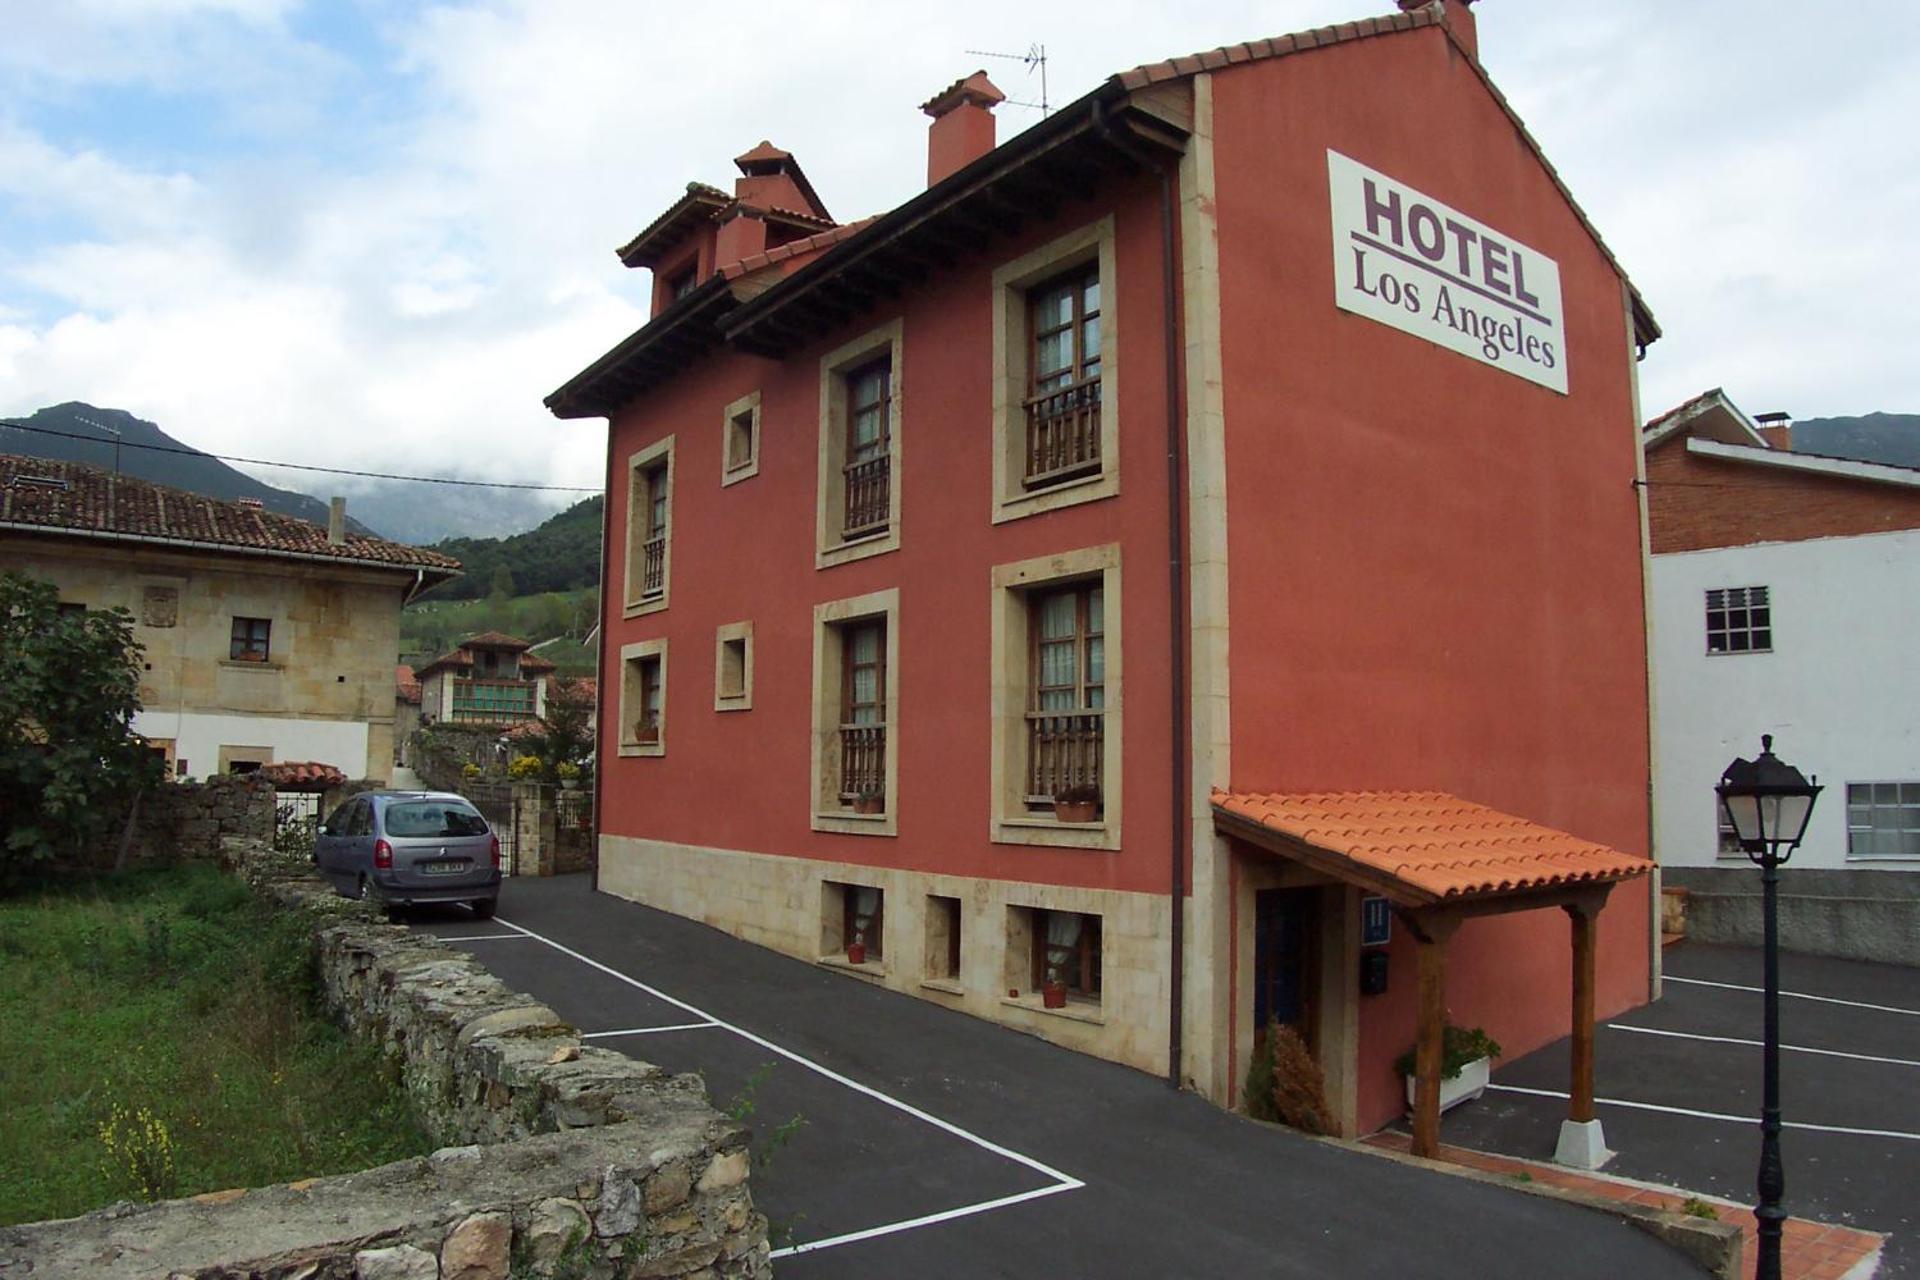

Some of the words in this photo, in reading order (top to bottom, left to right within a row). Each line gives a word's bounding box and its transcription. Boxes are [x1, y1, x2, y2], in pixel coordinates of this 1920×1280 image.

[1362, 177, 1539, 309] HOTEL
[1351, 246, 1421, 314] Los
[1431, 284, 1556, 369] Angeles
